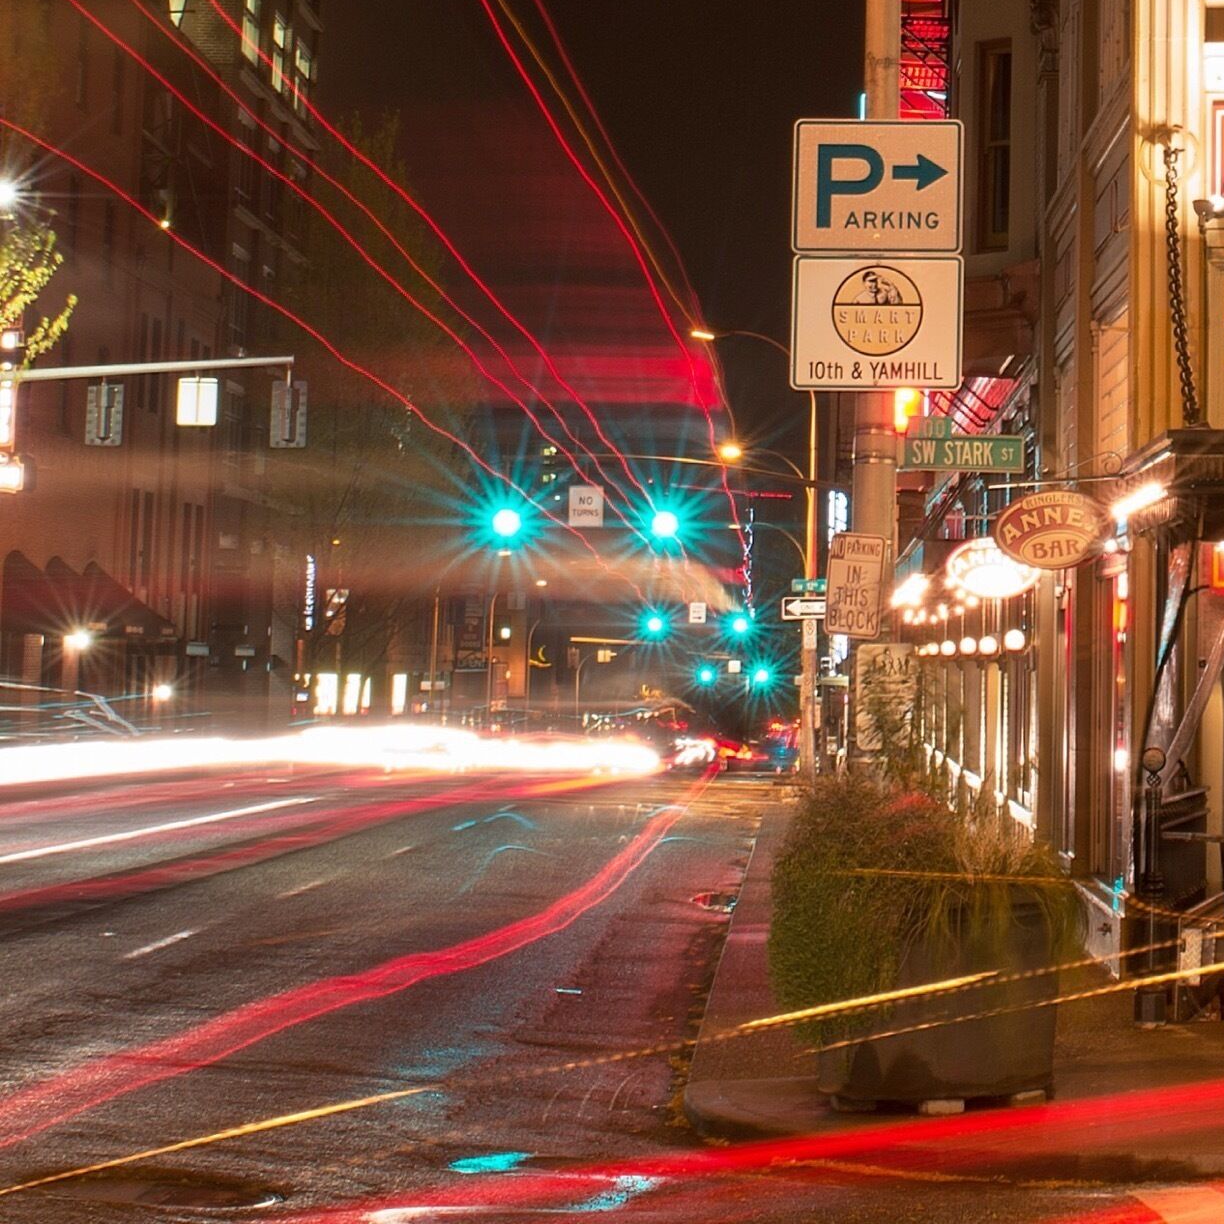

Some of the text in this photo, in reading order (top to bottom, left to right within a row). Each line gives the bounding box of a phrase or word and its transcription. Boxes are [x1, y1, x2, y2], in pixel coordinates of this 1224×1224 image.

[838, 310, 915, 325] SMART
[847, 329, 904, 344] PARK
[808, 361, 944, 380] 10th & YAMHILL
[912, 439, 1014, 466] SW STARK ST
[578, 496, 593, 506] NO
[571, 508, 600, 517] TURNS
[831, 537, 881, 559] NO PARKING
[1031, 539, 1080, 560] BAR
[846, 565, 863, 584] IN
[835, 586, 869, 607] THIS
[829, 609, 877, 630] BLOCK
